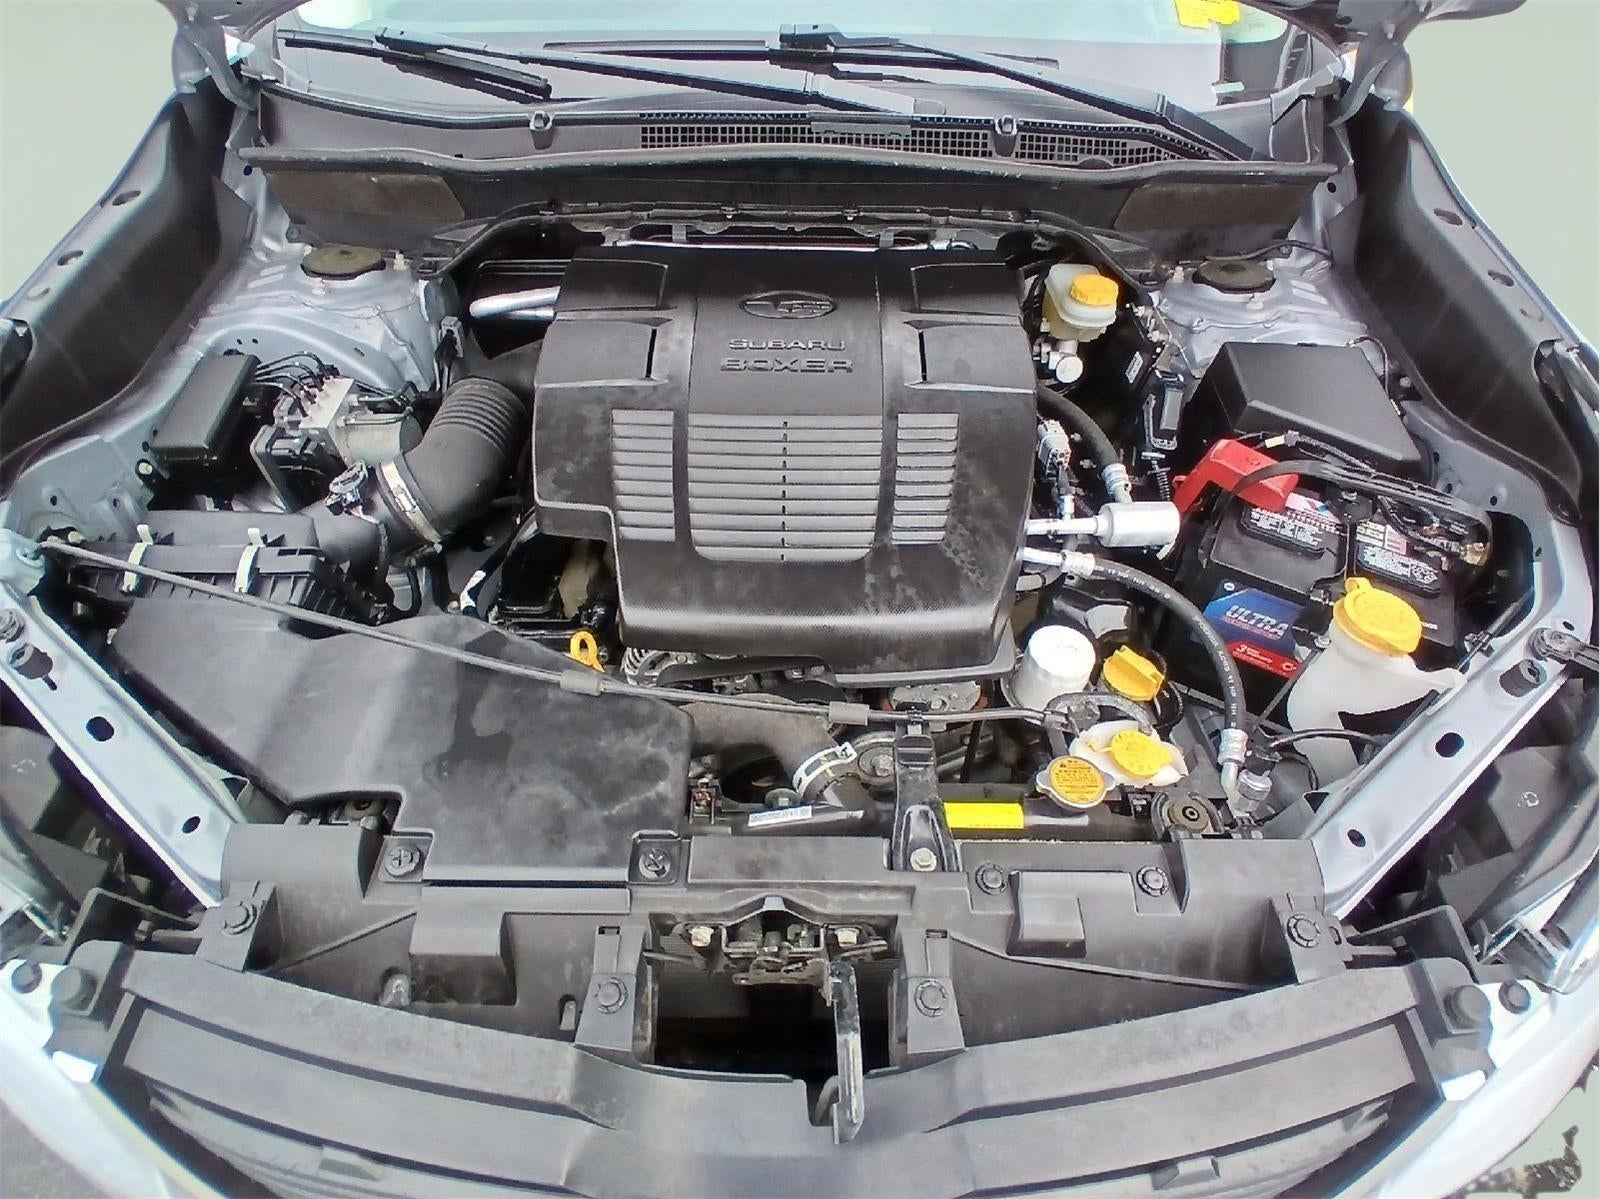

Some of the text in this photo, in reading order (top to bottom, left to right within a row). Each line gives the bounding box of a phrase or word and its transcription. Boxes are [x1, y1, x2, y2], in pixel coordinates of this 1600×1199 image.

[728, 338, 846, 351] SUBARU
[720, 357, 853, 374] BOXER
[1225, 604, 1290, 637] ULTRA
